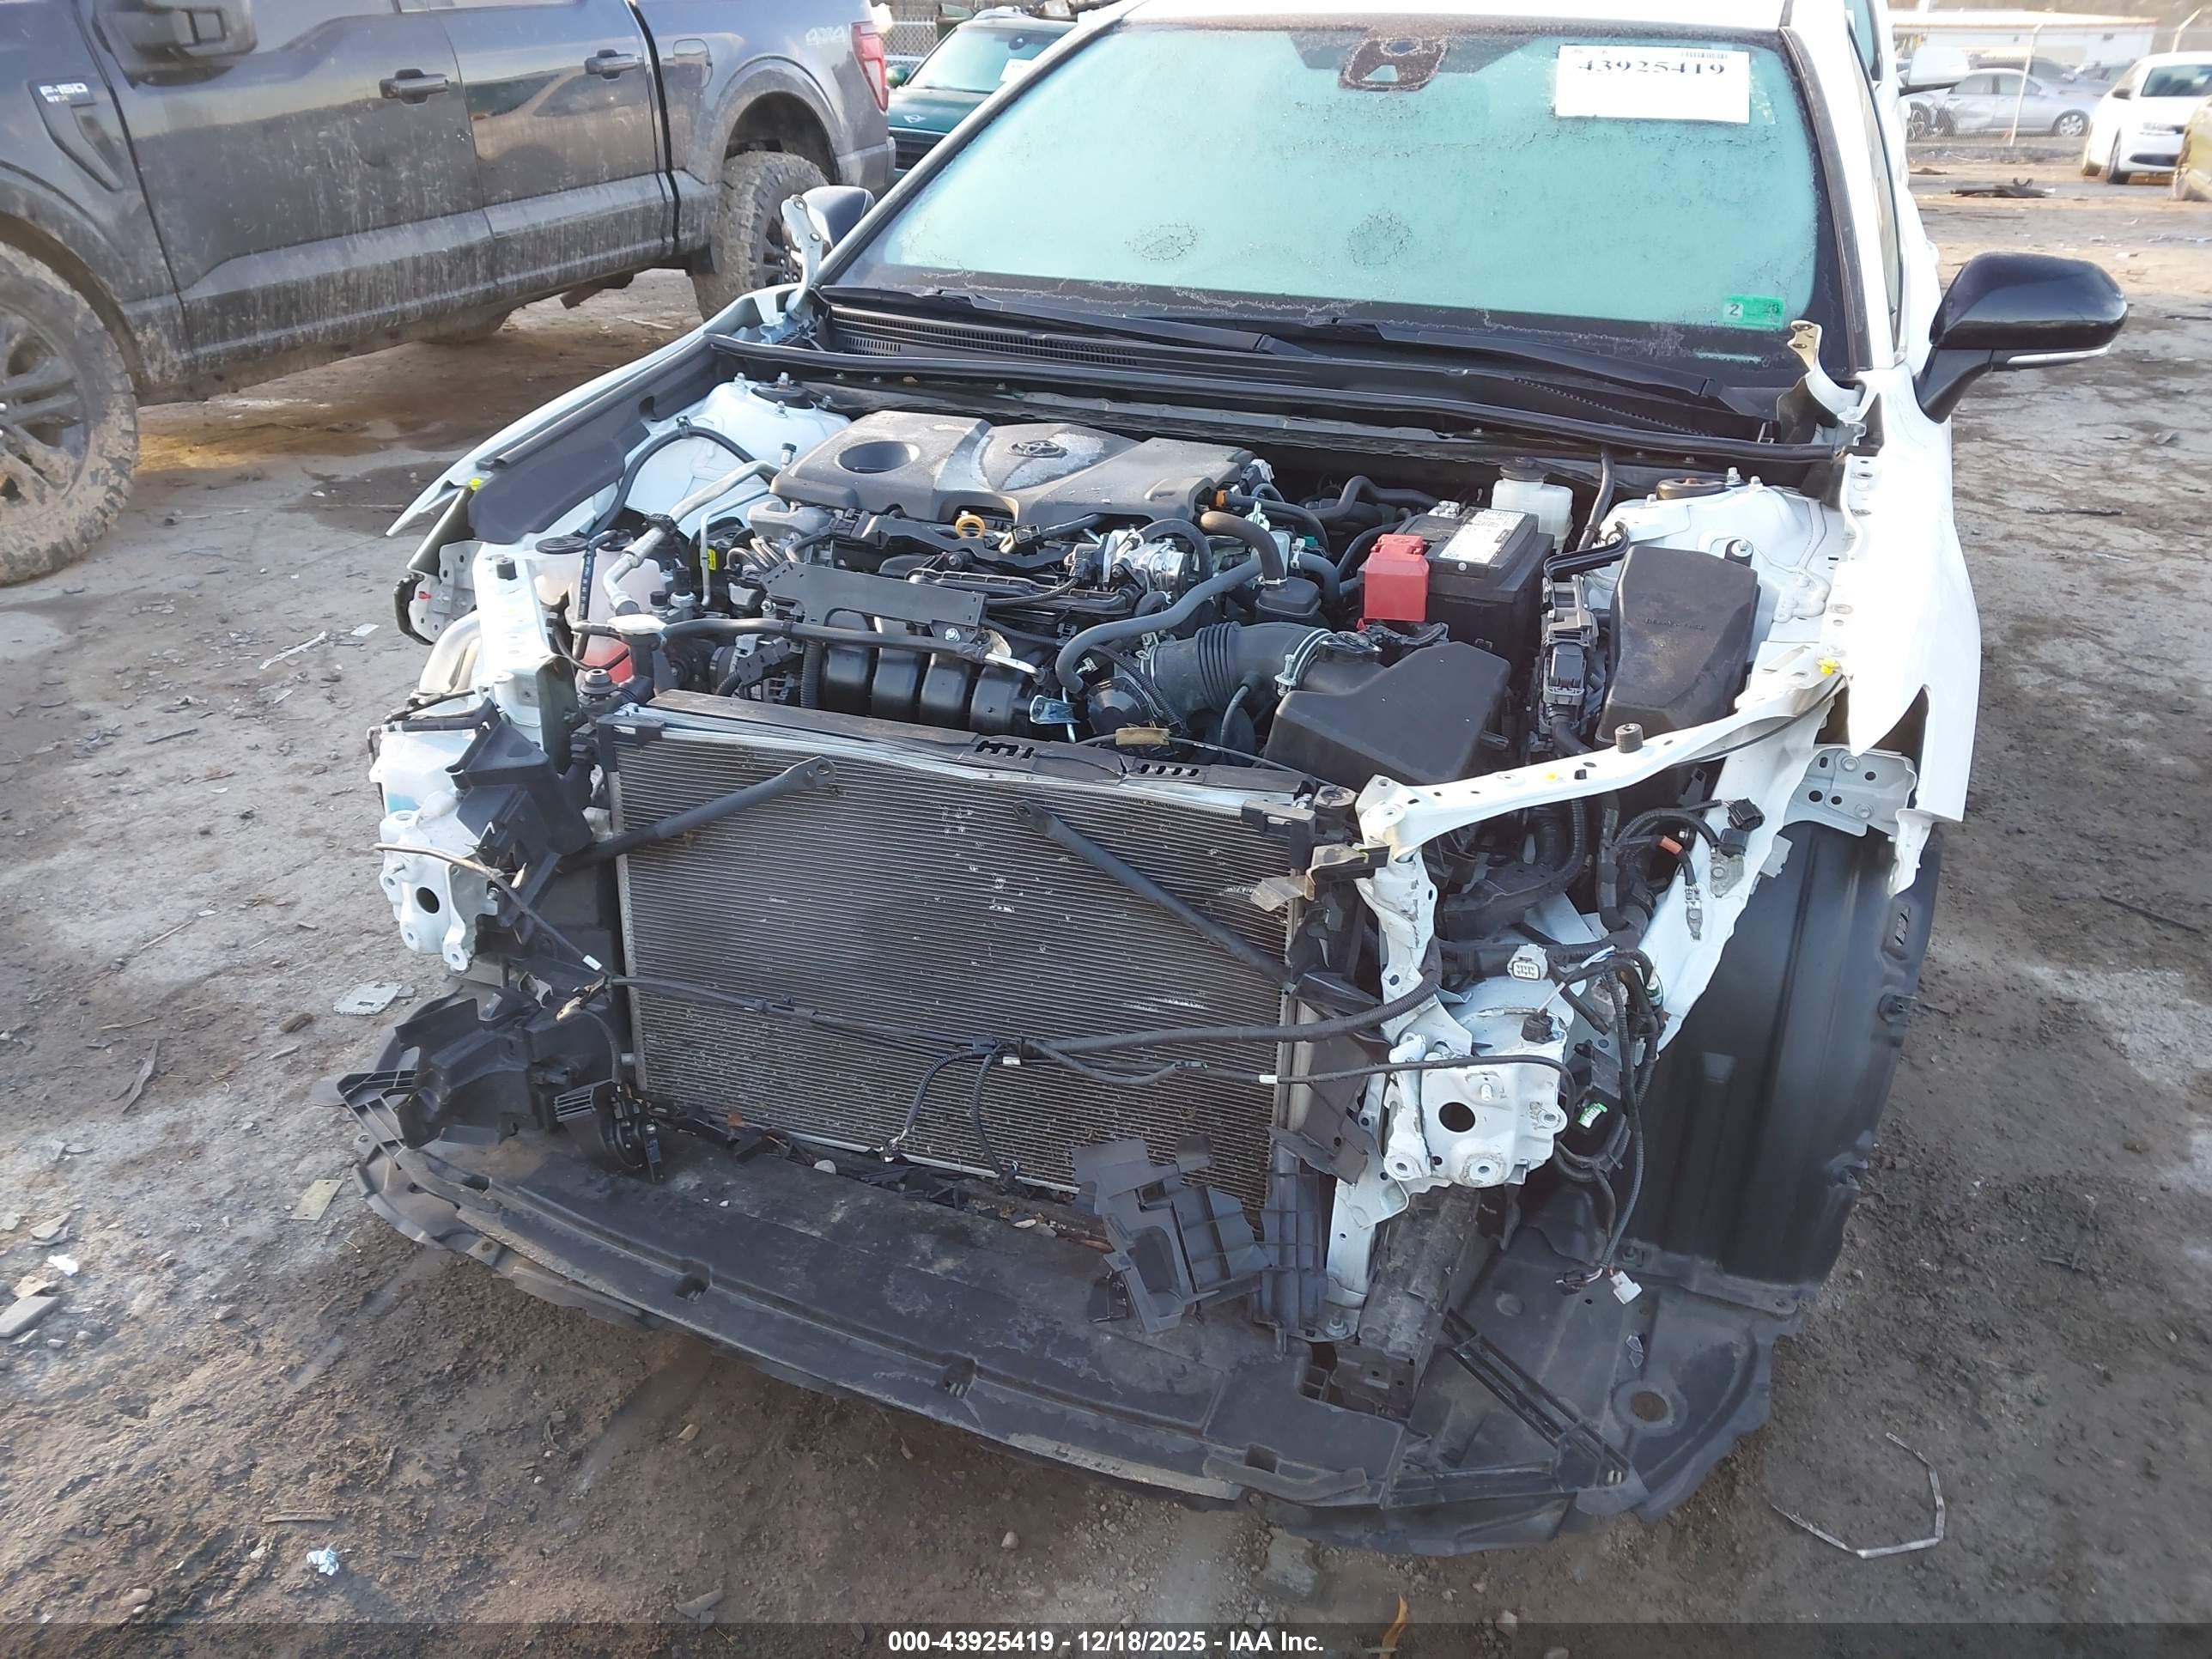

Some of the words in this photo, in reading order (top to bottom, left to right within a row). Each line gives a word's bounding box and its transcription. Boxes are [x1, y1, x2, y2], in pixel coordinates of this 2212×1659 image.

[1578, 59, 1725, 76] 43925419
[39, 82, 88, 96] F-150
[1729, 303, 1740, 316] 2
